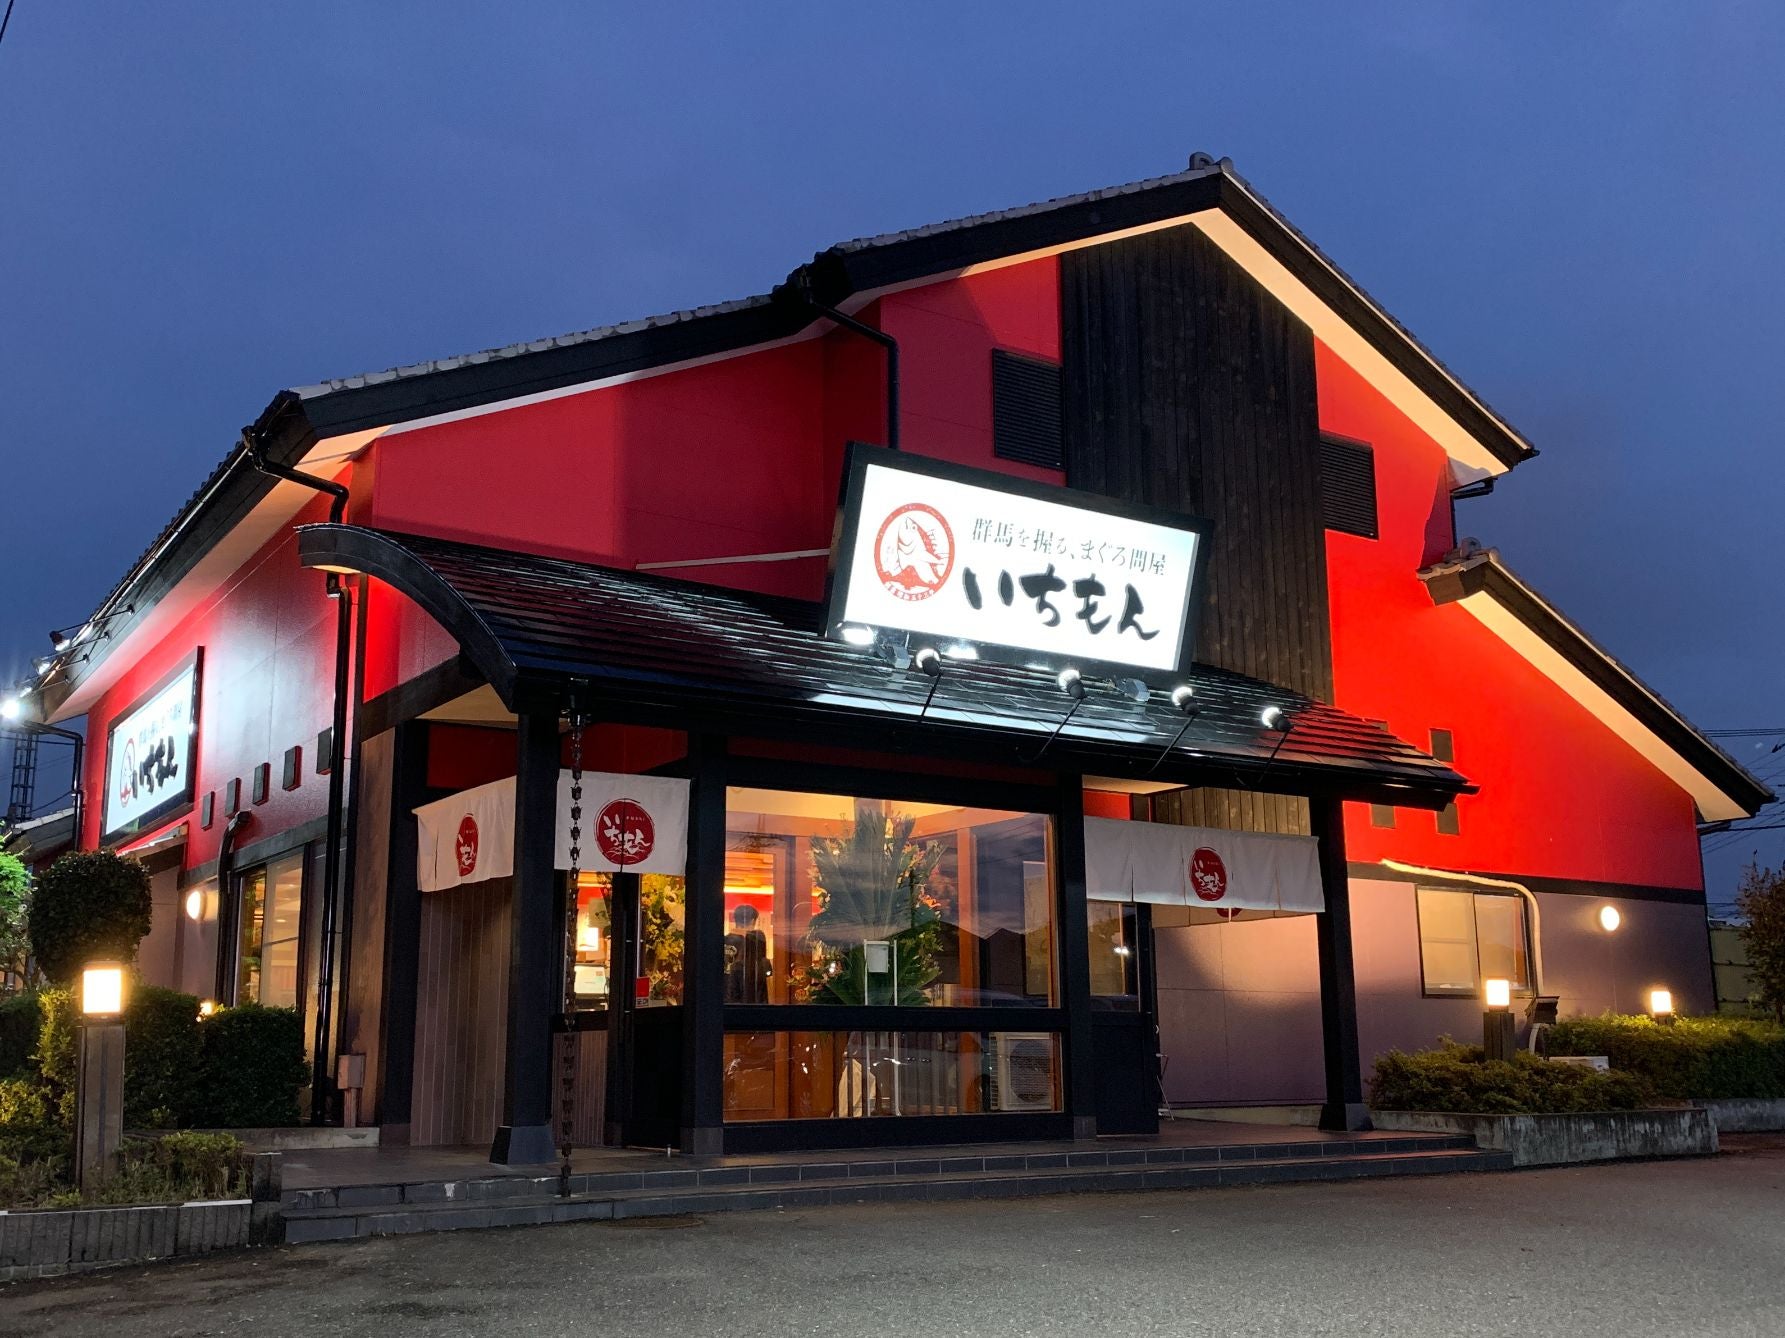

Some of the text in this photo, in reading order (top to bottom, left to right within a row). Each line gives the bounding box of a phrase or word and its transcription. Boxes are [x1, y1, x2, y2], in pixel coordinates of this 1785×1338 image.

[972, 518, 1167, 576] 群馬を握る、まぐろ問屋
[962, 563, 1161, 641] いちもん
